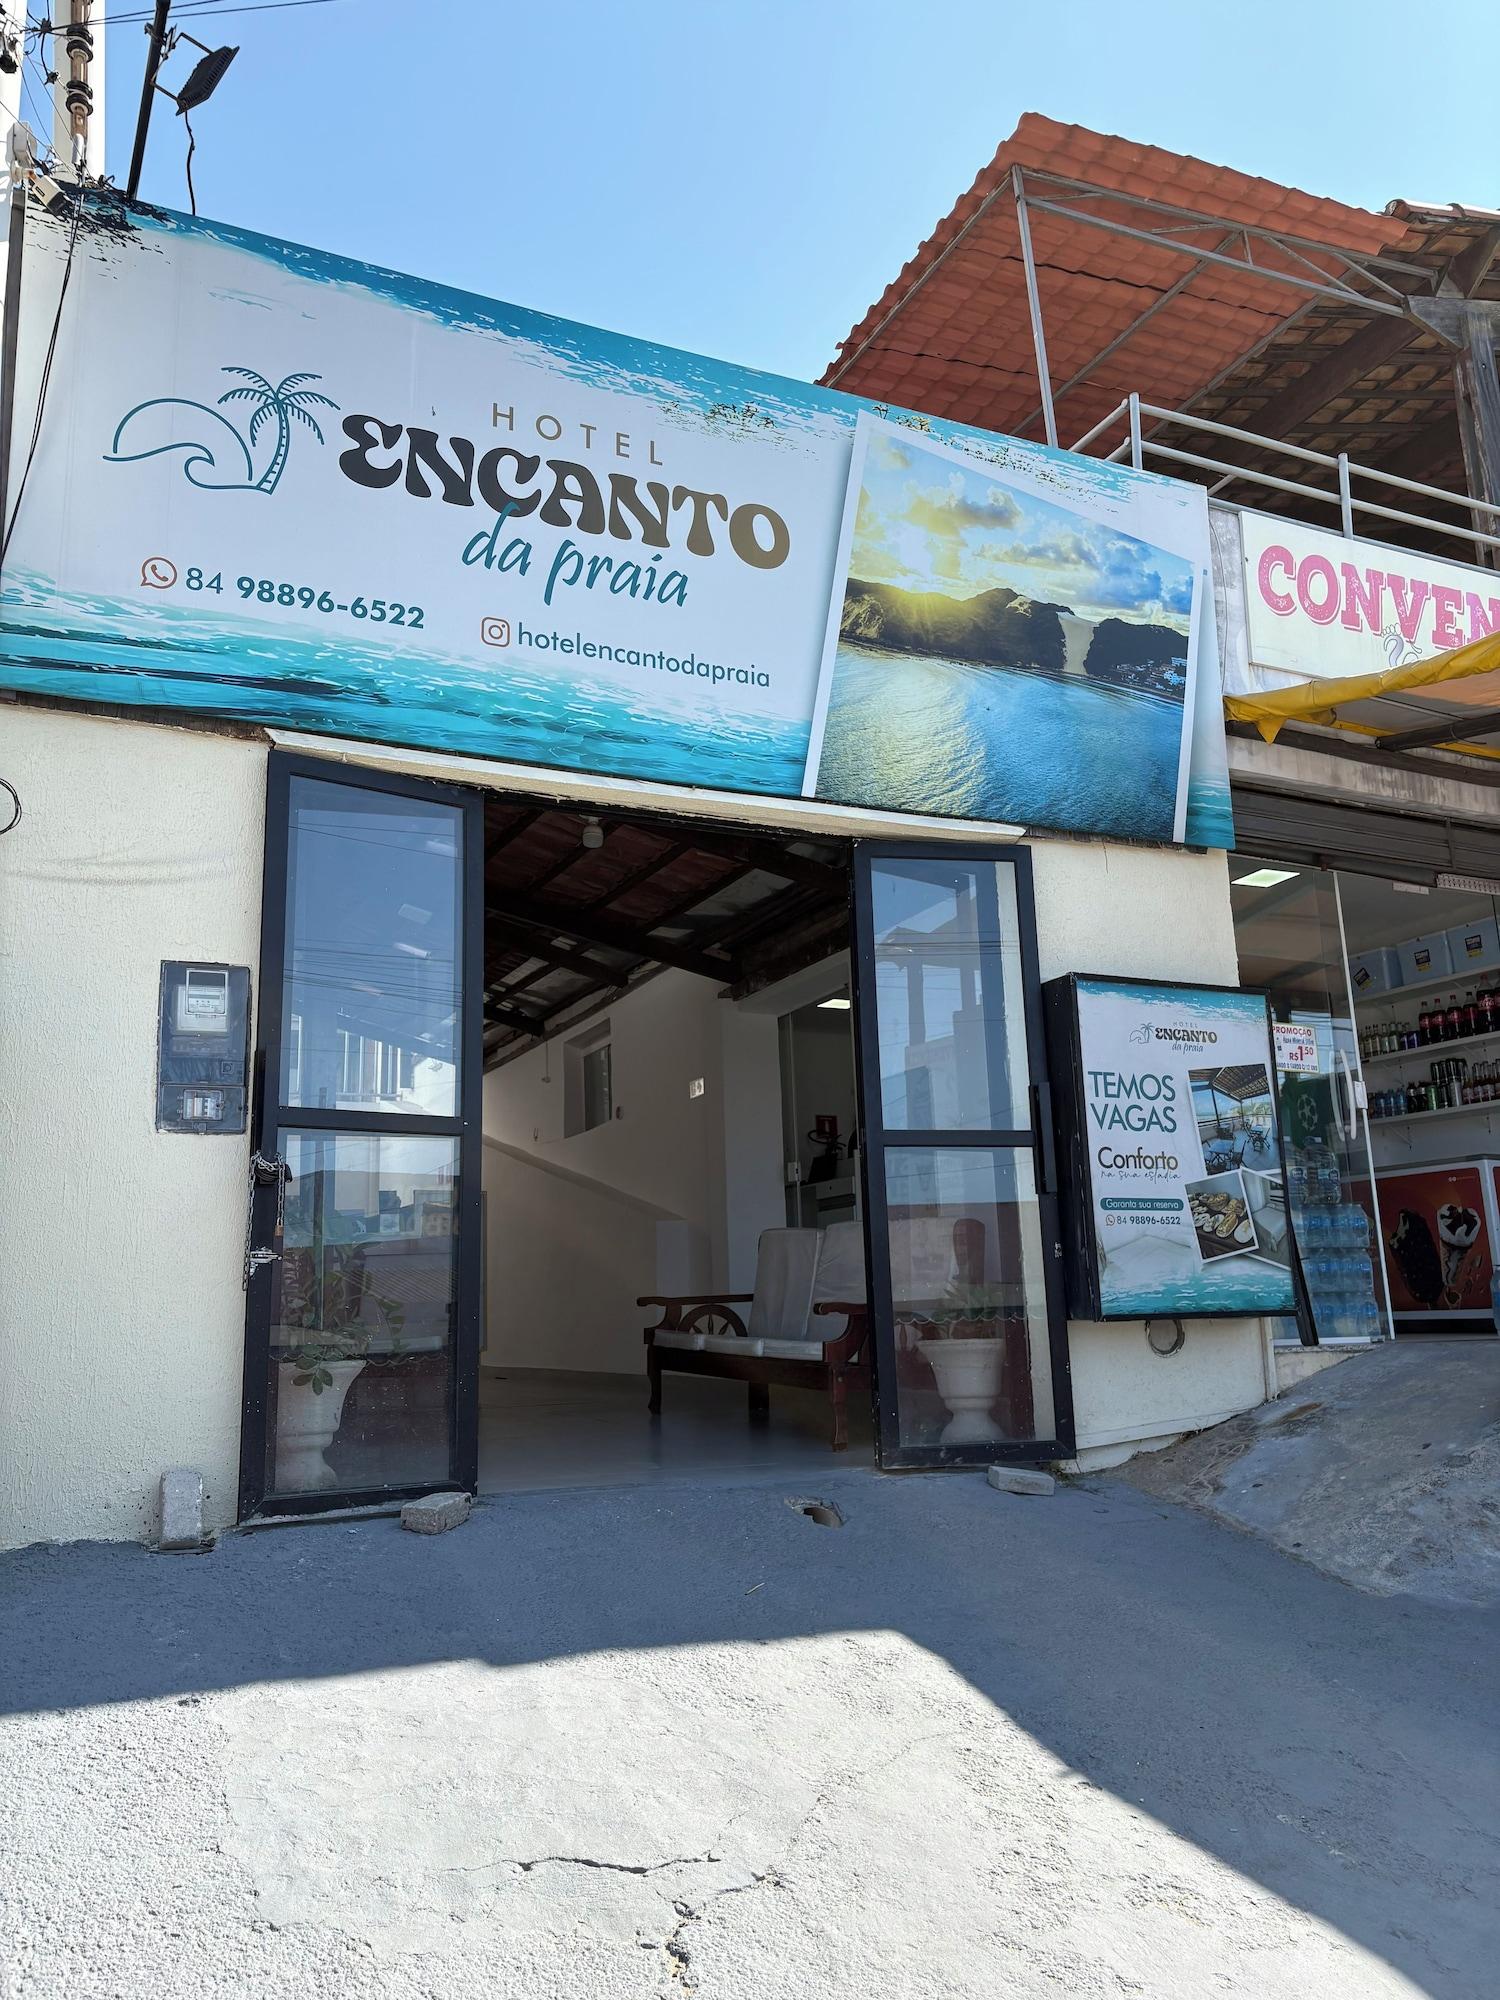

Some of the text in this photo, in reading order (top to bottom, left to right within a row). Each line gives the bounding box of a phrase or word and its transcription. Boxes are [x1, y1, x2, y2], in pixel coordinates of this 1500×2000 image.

[492, 402, 663, 466] HOTEL
[338, 413, 791, 570] ENCANTO
[461, 502, 689, 608] da praia
[185, 567, 425, 629] 84 98896-6522
[518, 621, 770, 687] hotelencantodapraia
[1154, 1027, 1218, 1044] ENCANTO
[1171, 1039, 1204, 1055] da praia
[1087, 1071, 1176, 1102] TEMOS
[1090, 1103, 1177, 1133] VAGAS
[1097, 1146, 1179, 1171] Conforto
[1105, 1198, 1179, 1209] Garanta sua reserva
[1116, 1215, 1181, 1225] 84 98896-6522
